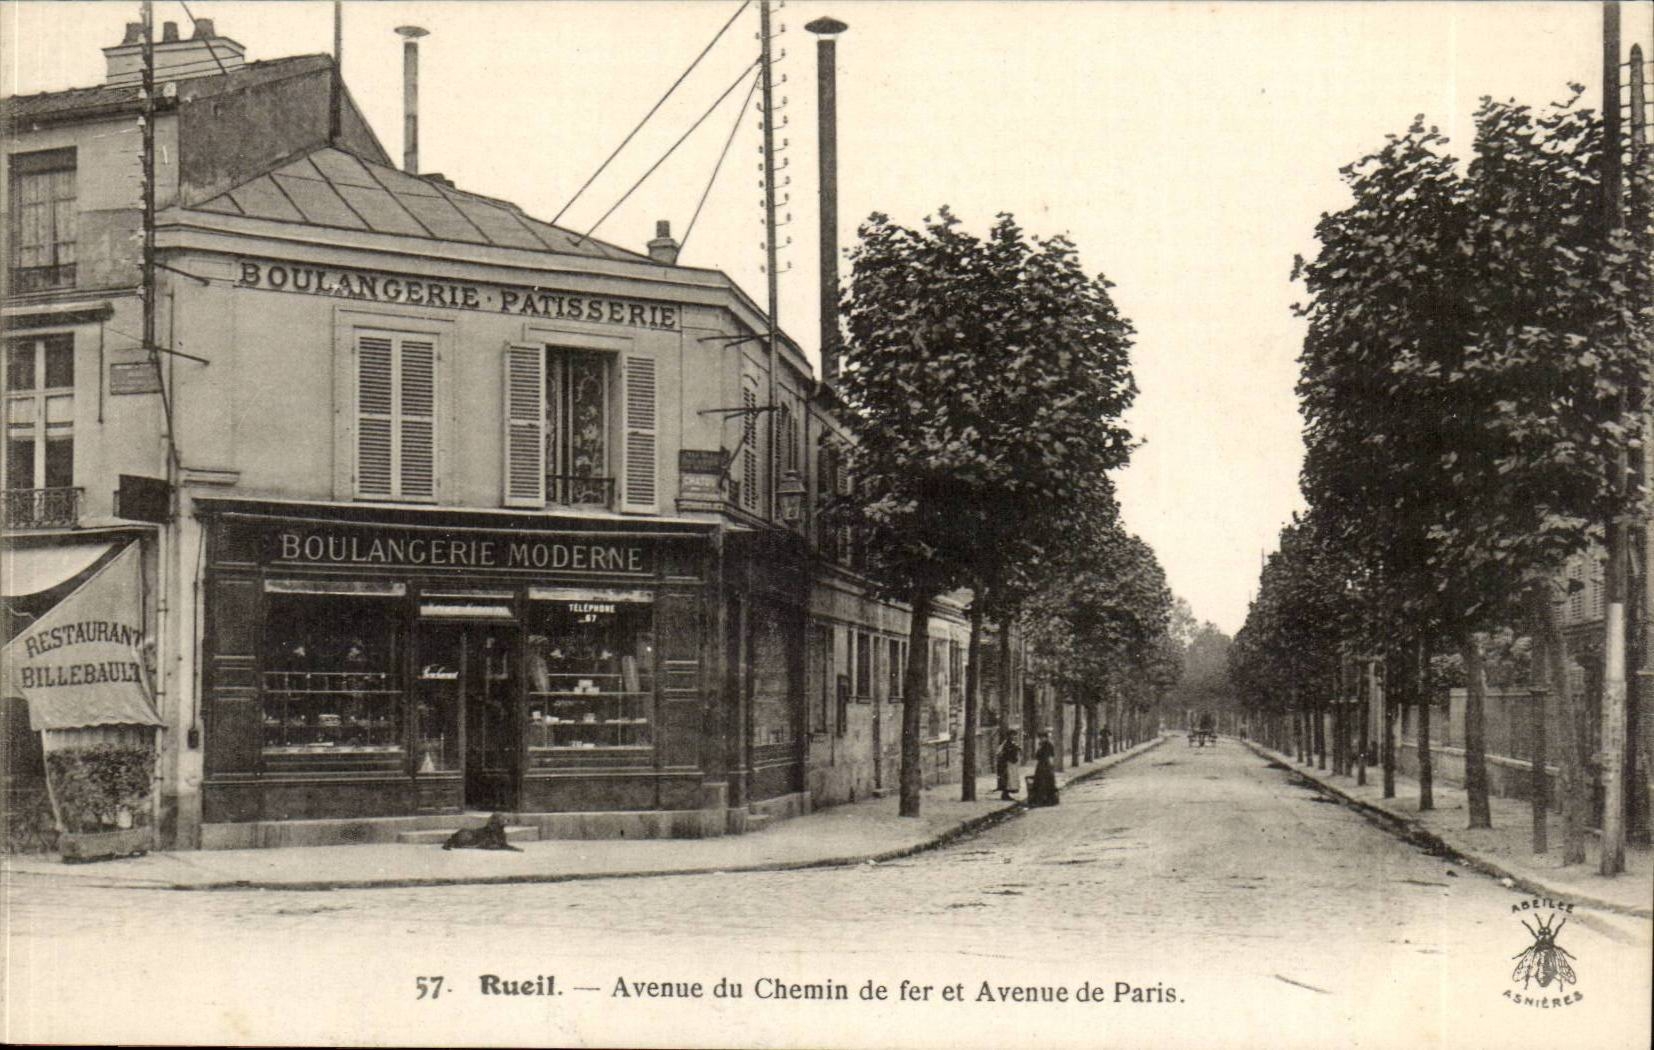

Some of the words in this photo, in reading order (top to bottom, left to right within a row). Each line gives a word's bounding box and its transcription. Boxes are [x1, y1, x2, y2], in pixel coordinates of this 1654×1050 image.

[240, 262, 480, 309] BOULANGERIE
[500, 288, 676, 329] PATISSERIE
[282, 533, 496, 566] BOULANGERIE
[508, 543, 643, 571] MODERNE
[25, 620, 143, 658] RESTAURANT
[21, 661, 141, 689] BILLEBAULT
